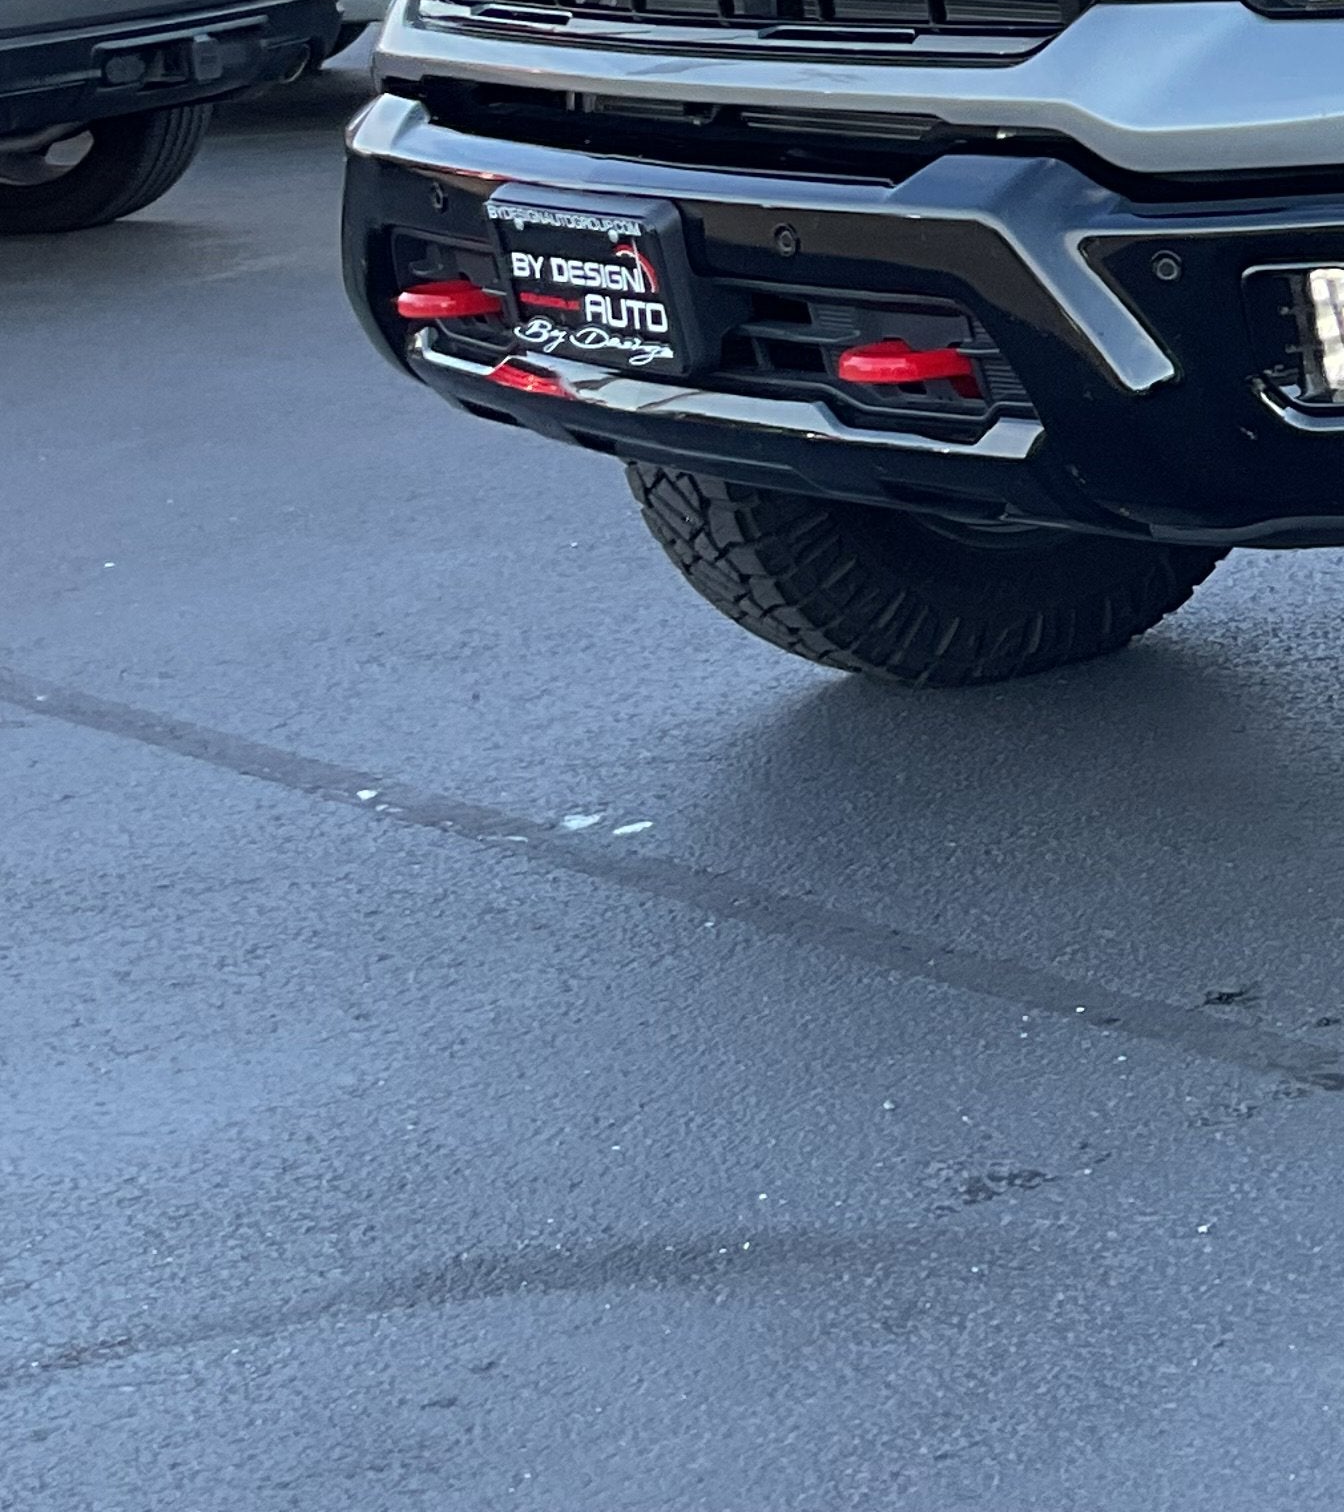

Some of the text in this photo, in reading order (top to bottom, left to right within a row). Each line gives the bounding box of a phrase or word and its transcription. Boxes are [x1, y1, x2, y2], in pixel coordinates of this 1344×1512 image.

[511, 251, 645, 292] BY DESIGN
[586, 294, 668, 332] AUTO
